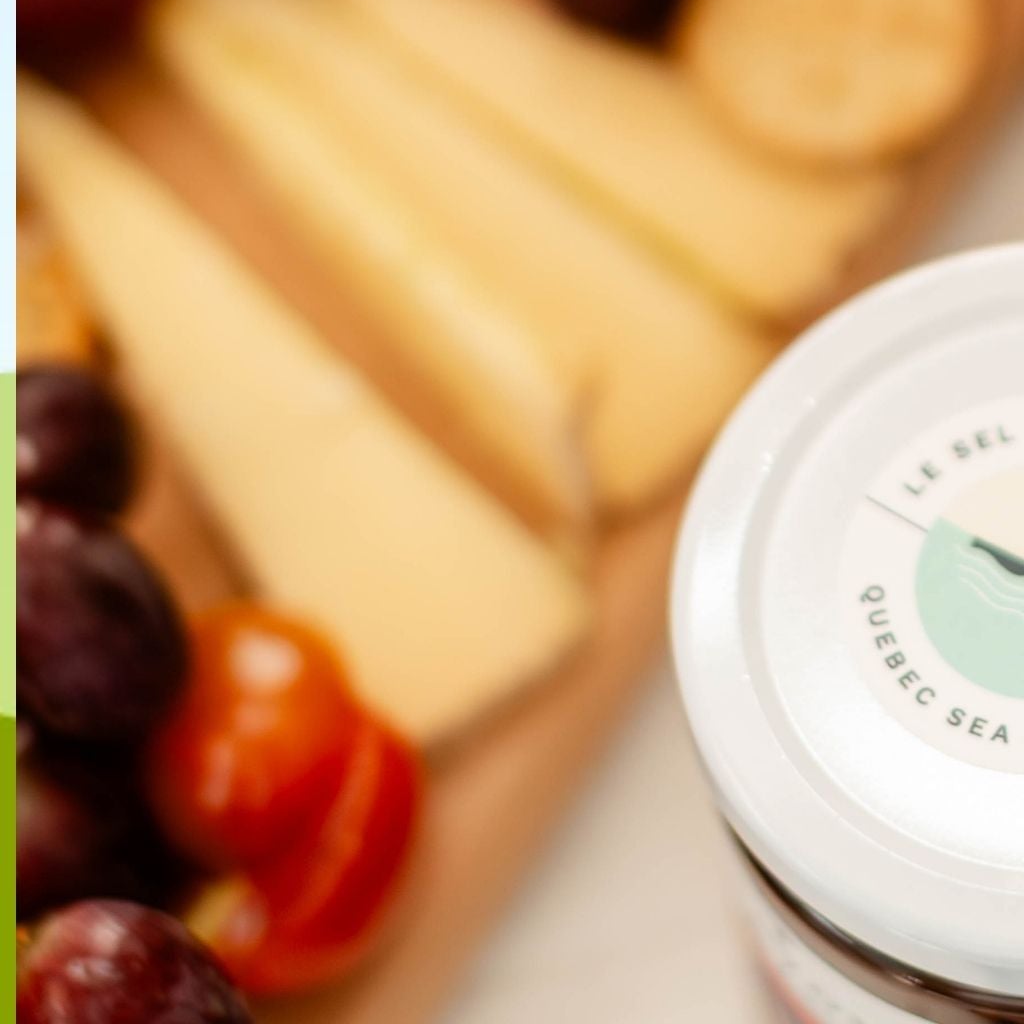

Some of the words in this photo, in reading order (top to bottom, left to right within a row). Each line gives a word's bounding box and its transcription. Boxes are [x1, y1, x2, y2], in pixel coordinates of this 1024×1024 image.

[904, 460, 941, 496] LE
[952, 425, 1014, 459] SEL
[860, 584, 936, 706] QUEBEC
[946, 707, 1010, 744] SEA
